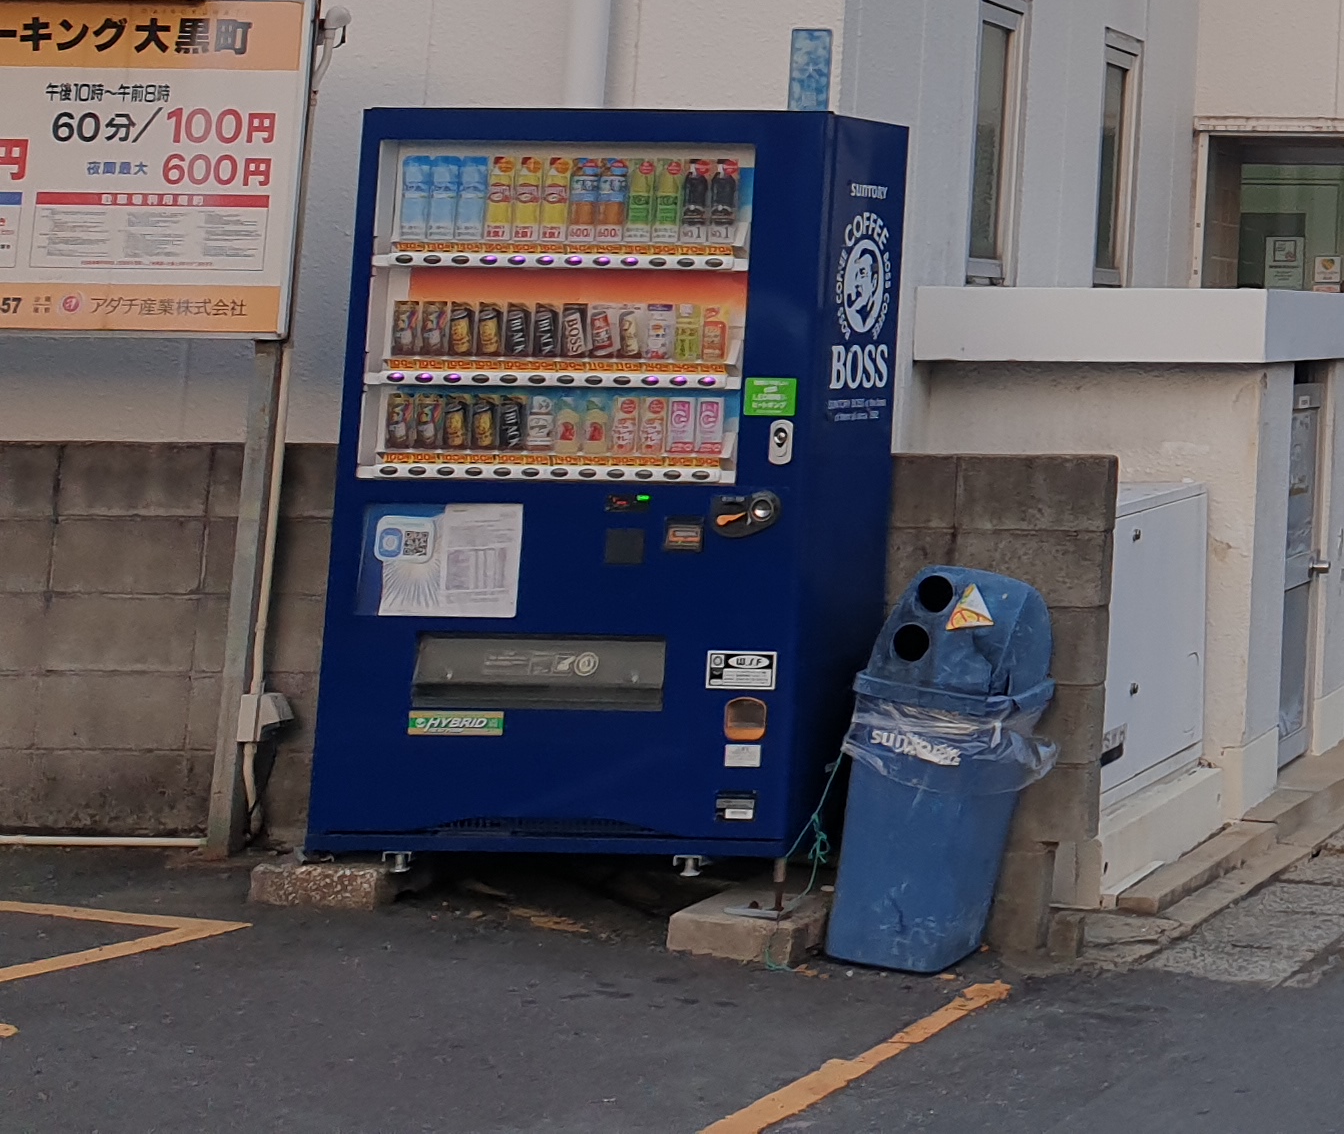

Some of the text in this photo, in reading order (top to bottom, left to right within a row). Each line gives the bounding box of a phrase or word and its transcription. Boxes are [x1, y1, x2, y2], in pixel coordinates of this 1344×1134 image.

[161, 153, 272, 187] 600円
[850, 183, 889, 200] SUNTORY
[844, 211, 890, 248] COFFEE
[89, 297, 248, 318] アダチ産業株式会社
[565, 317, 582, 354] BOSS
[830, 344, 888, 390] BOSS
[426, 717, 488, 731] HYBRID
